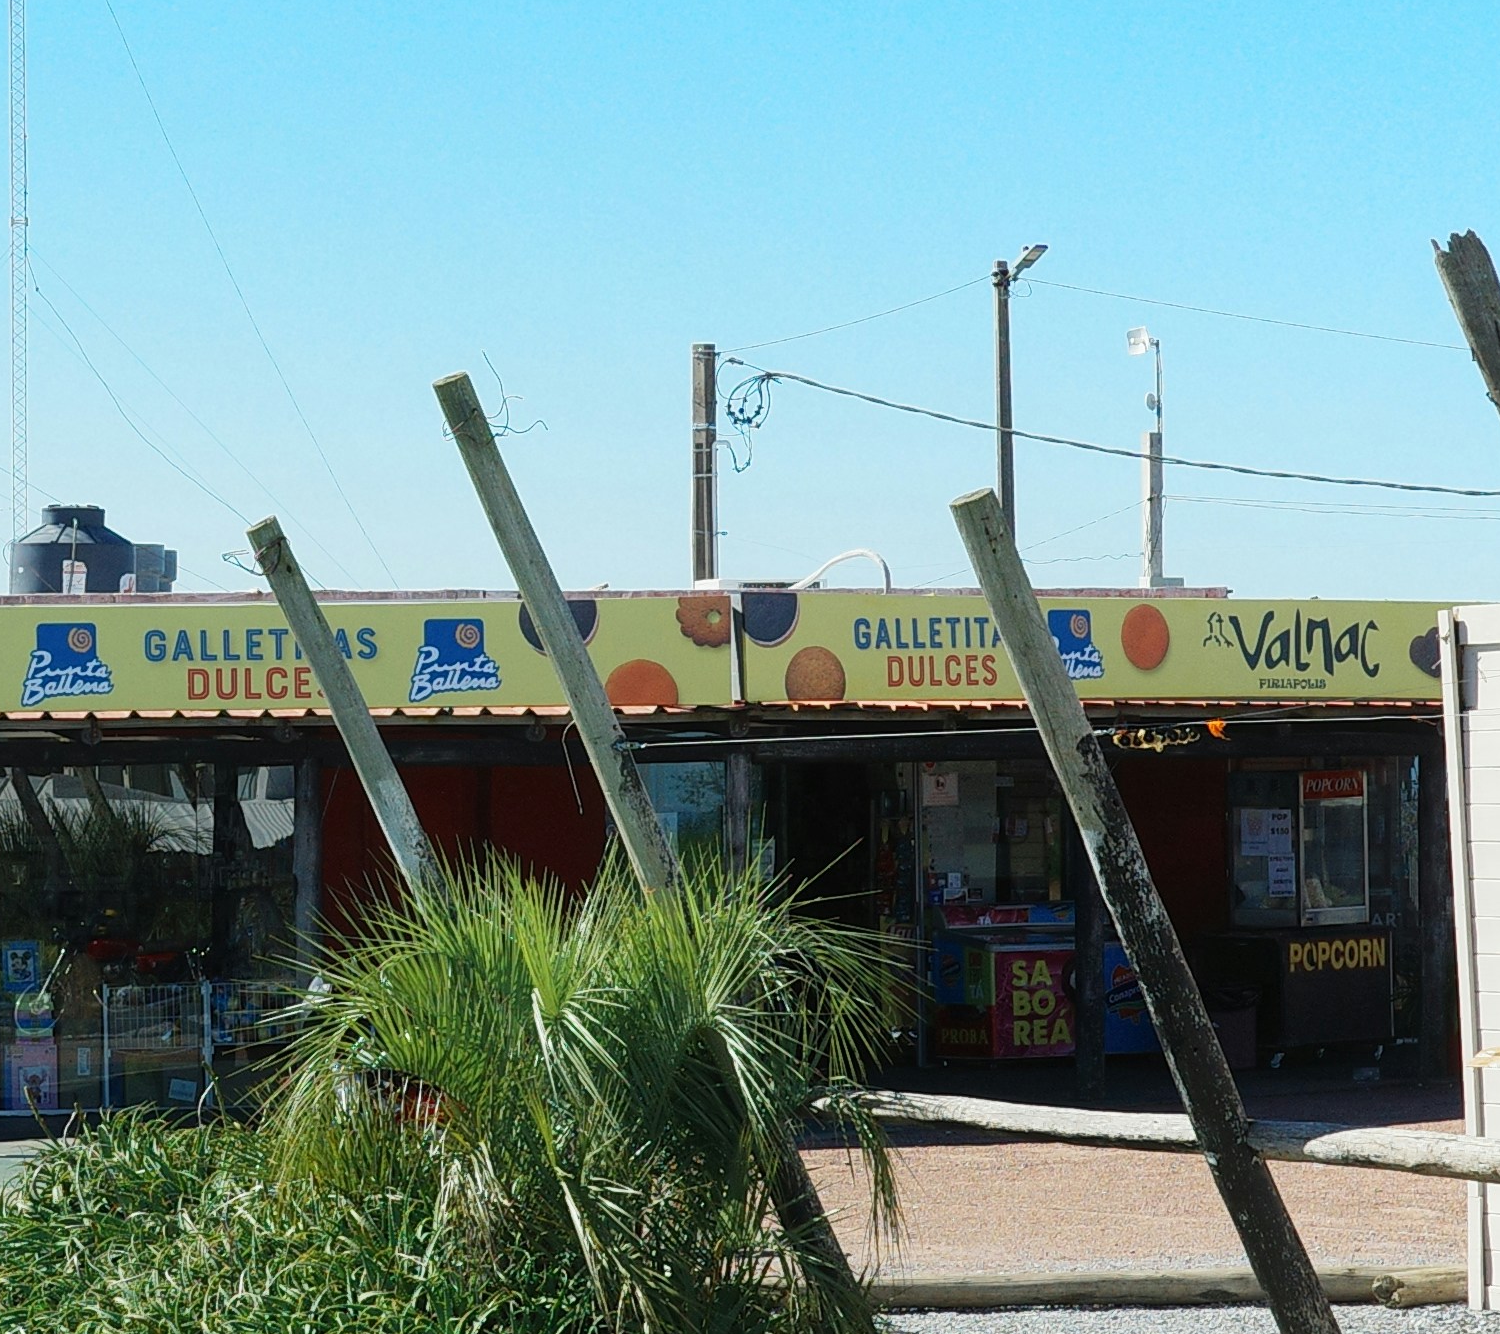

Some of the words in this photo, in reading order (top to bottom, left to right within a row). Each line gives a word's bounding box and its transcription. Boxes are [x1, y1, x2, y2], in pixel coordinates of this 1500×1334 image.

[144, 627, 378, 663] GALLETAS
[853, 617, 1001, 650] GALLETIT
[28, 651, 110, 678] Punta
[416, 646, 499, 674] Punta
[887, 654, 998, 688] DULCES
[22, 674, 114, 705] Ballena
[187, 666, 326, 700] DULCE
[410, 670, 501, 701] Ballena
[1306, 777, 1359, 793] POPCORN
[1289, 937, 1386, 973] POPCORN
[1011, 959, 1053, 987] SA
[1012, 989, 1056, 1017] BO
[1013, 1007, 1073, 1047] REÁ
